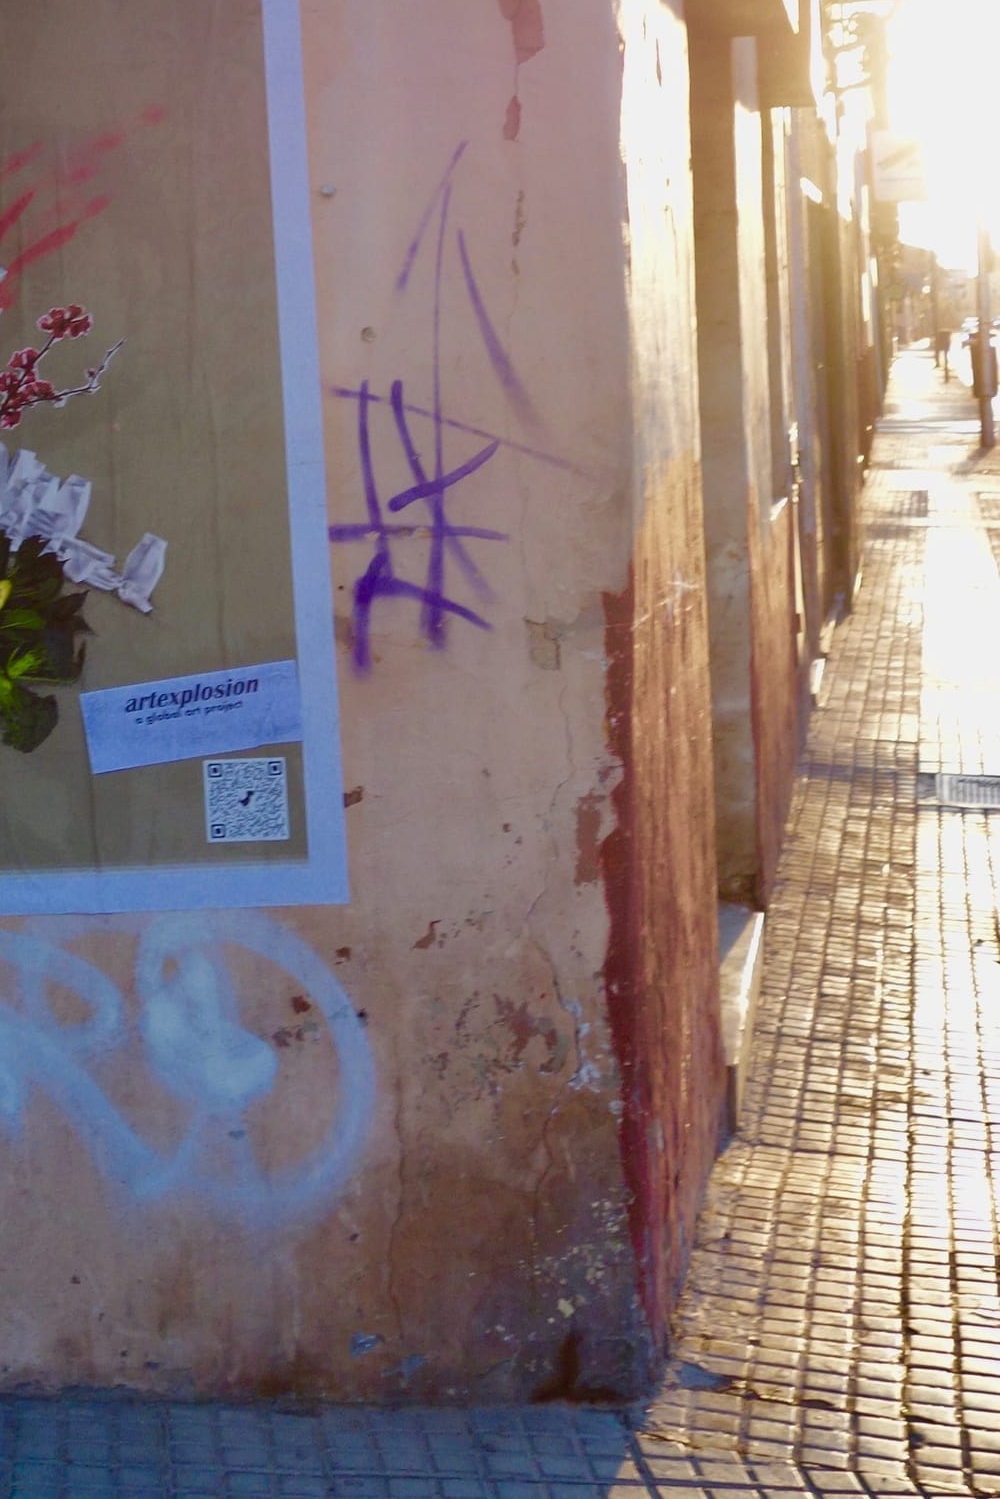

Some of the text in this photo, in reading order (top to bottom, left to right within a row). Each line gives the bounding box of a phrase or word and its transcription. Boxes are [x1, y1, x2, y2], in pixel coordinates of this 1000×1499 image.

[125, 678, 259, 713] artexplosion
[145, 709, 183, 725] global
[184, 706, 201, 717] art
